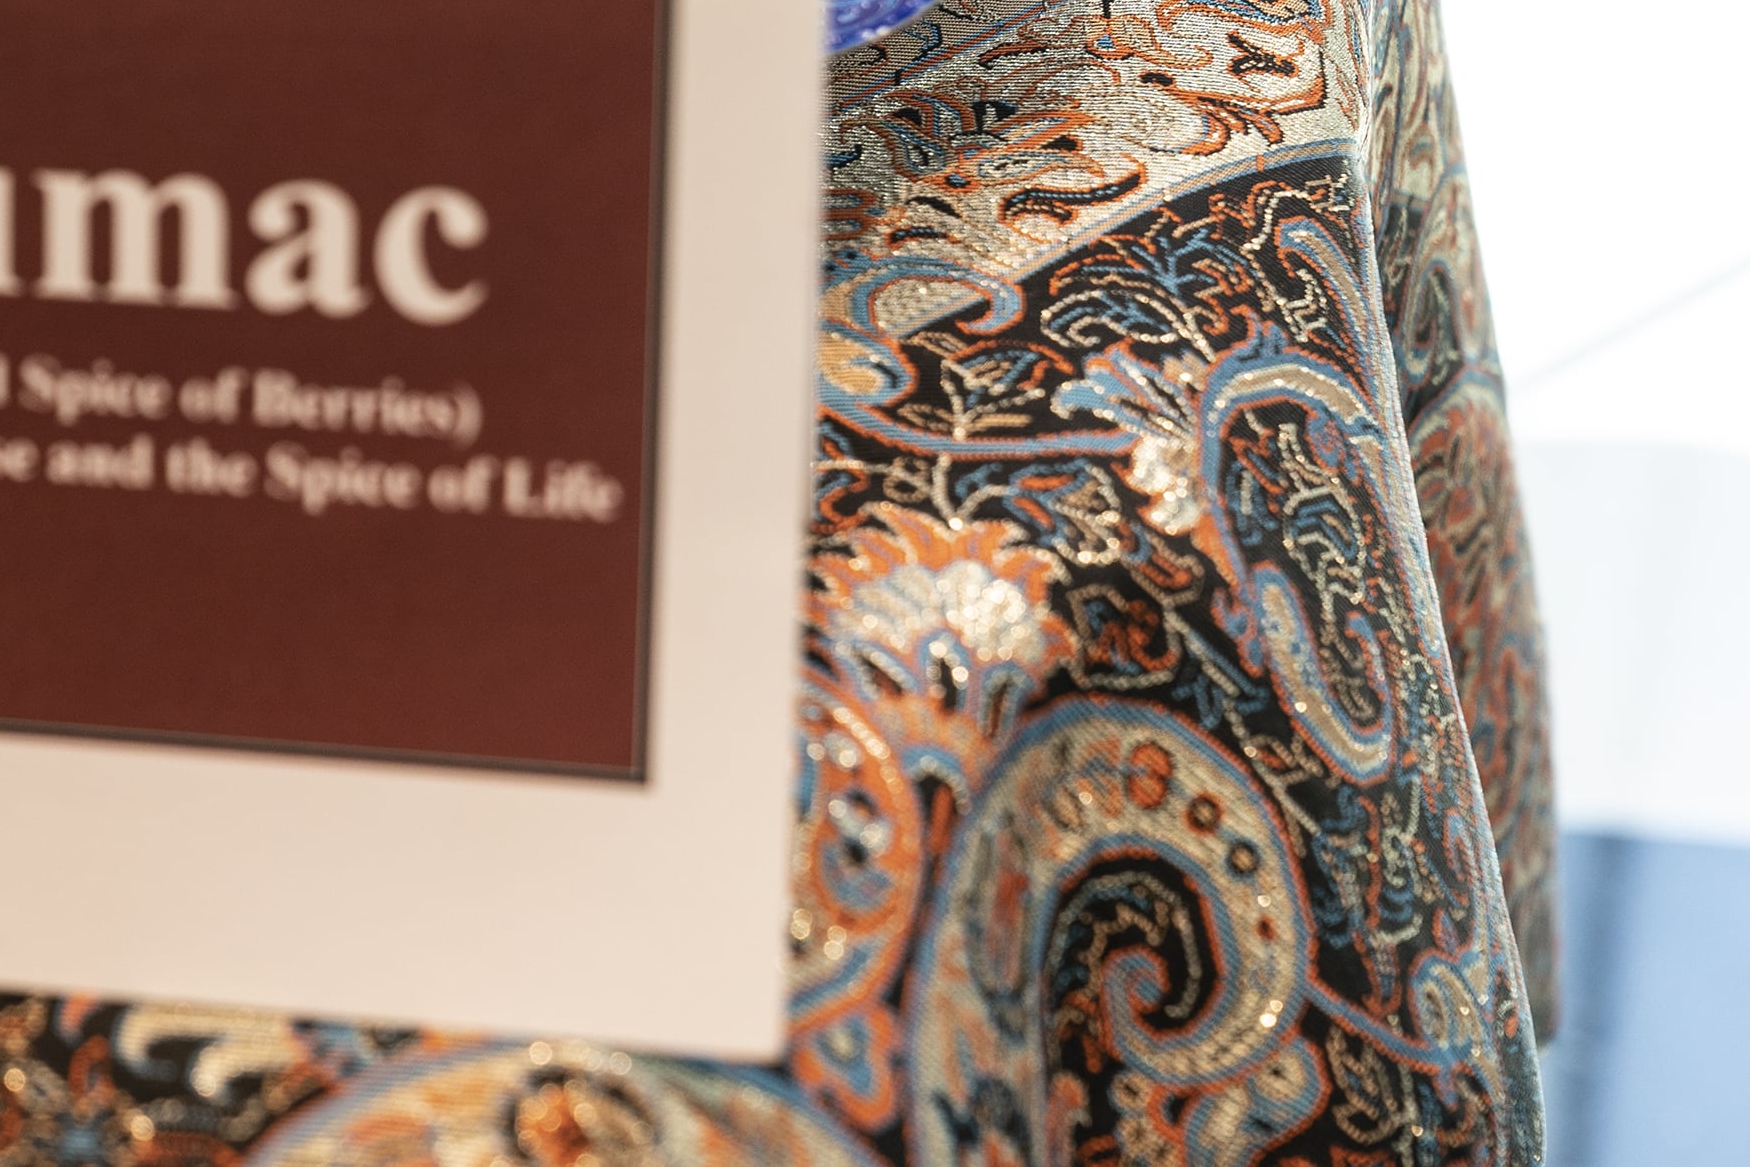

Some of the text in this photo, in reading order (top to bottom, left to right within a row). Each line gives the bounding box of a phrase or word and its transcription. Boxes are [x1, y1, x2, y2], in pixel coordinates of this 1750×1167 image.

[19, 353, 172, 426] Spice
[179, 366, 251, 424] of
[253, 368, 484, 449] Berries)
[45, 433, 155, 491] and
[164, 436, 258, 499] the
[264, 440, 423, 516] Spice
[427, 454, 500, 514] of
[503, 456, 624, 523] Life
